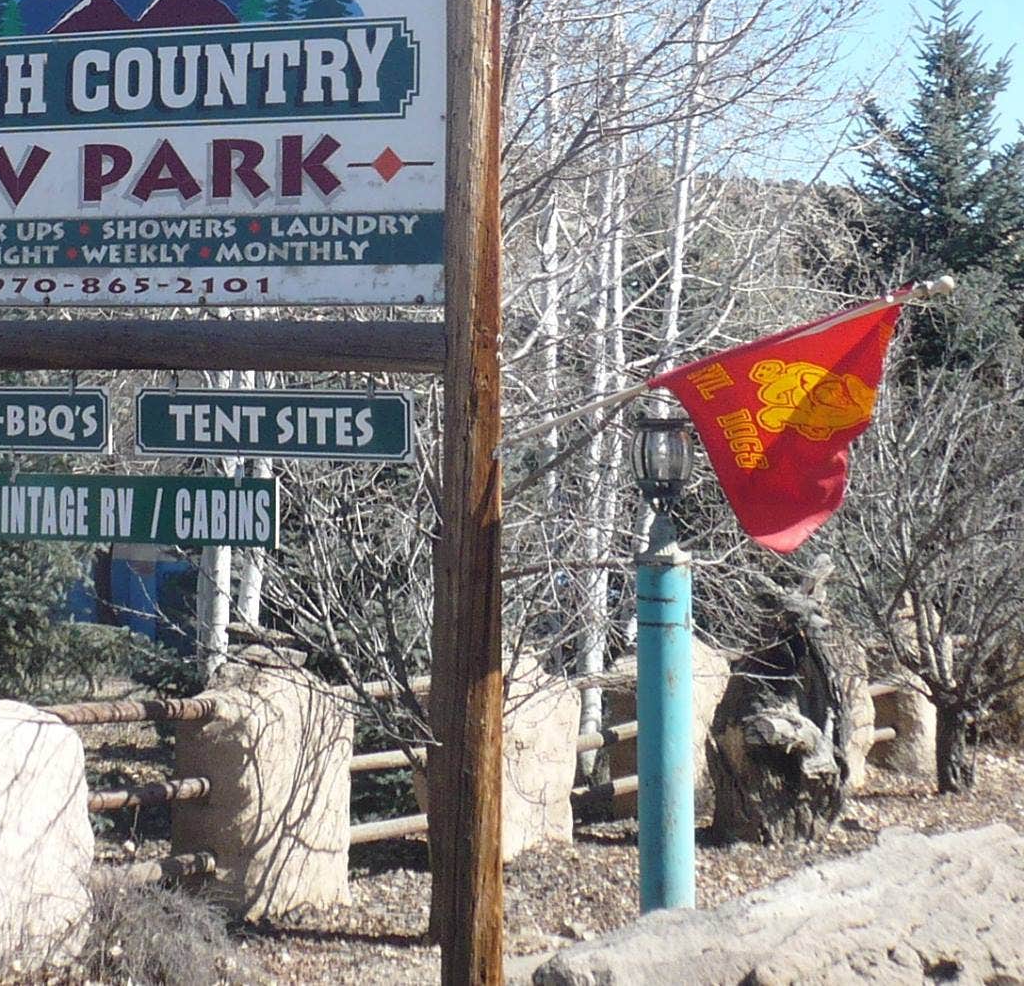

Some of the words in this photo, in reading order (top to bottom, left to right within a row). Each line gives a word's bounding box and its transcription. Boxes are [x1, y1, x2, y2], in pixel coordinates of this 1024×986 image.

[71, 27, 394, 114] COUNTRY
[82, 133, 343, 205] PARK
[16, 221, 66, 242] UPS
[102, 218, 238, 241] SHOWERS
[270, 214, 420, 238] LAUNDRY
[81, 243, 191, 264] WEEKLY
[214, 240, 371, 263] MONTHLY
[168, 403, 267, 444] TENT
[276, 405, 376, 448] SITES
[99, 486, 135, 539] RV
[174, 488, 272, 544] CABINS
